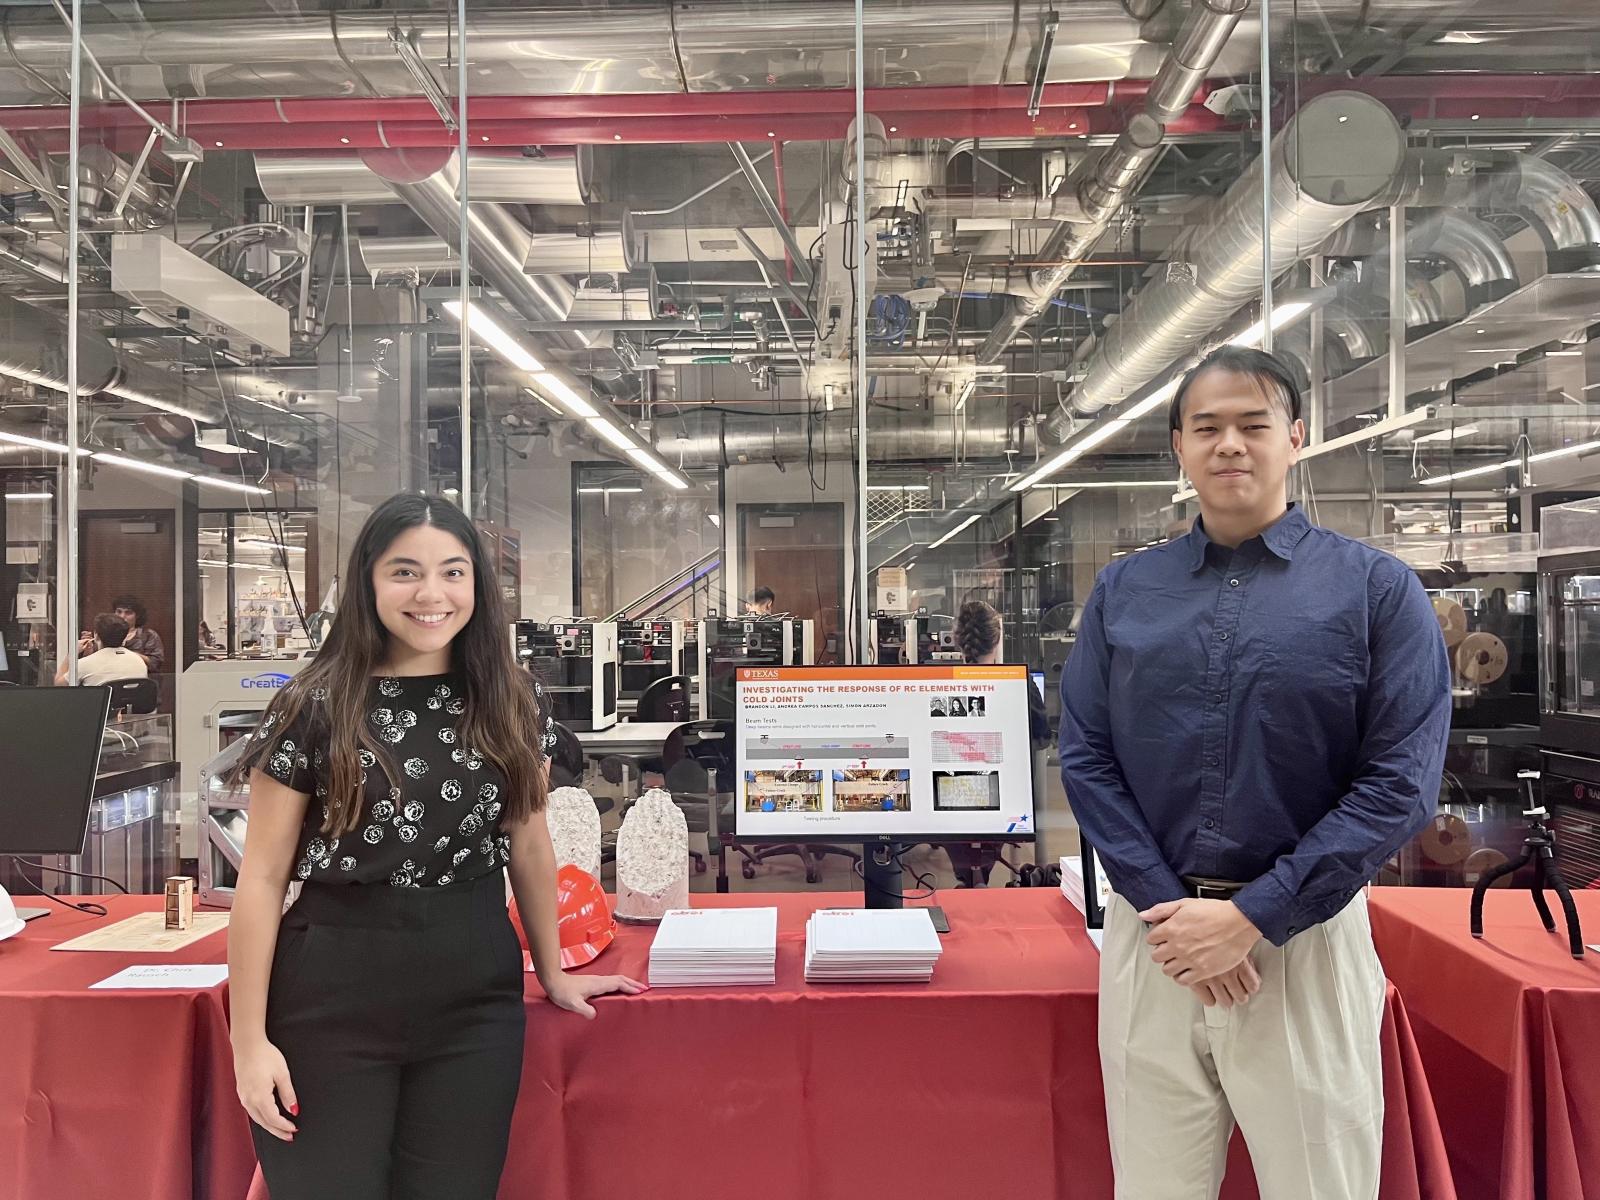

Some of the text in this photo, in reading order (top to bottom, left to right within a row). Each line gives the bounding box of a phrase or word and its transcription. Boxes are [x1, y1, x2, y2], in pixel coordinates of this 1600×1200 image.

[751, 669, 779, 677] TEXAS
[241, 678, 286, 688] CreatB
[742, 686, 814, 694] INVESTIGATING
[817, 685, 835, 693] THE
[837, 685, 887, 693] RESPONSE
[970, 684, 995, 692] WITH
[770, 695, 804, 703] JOINTS
